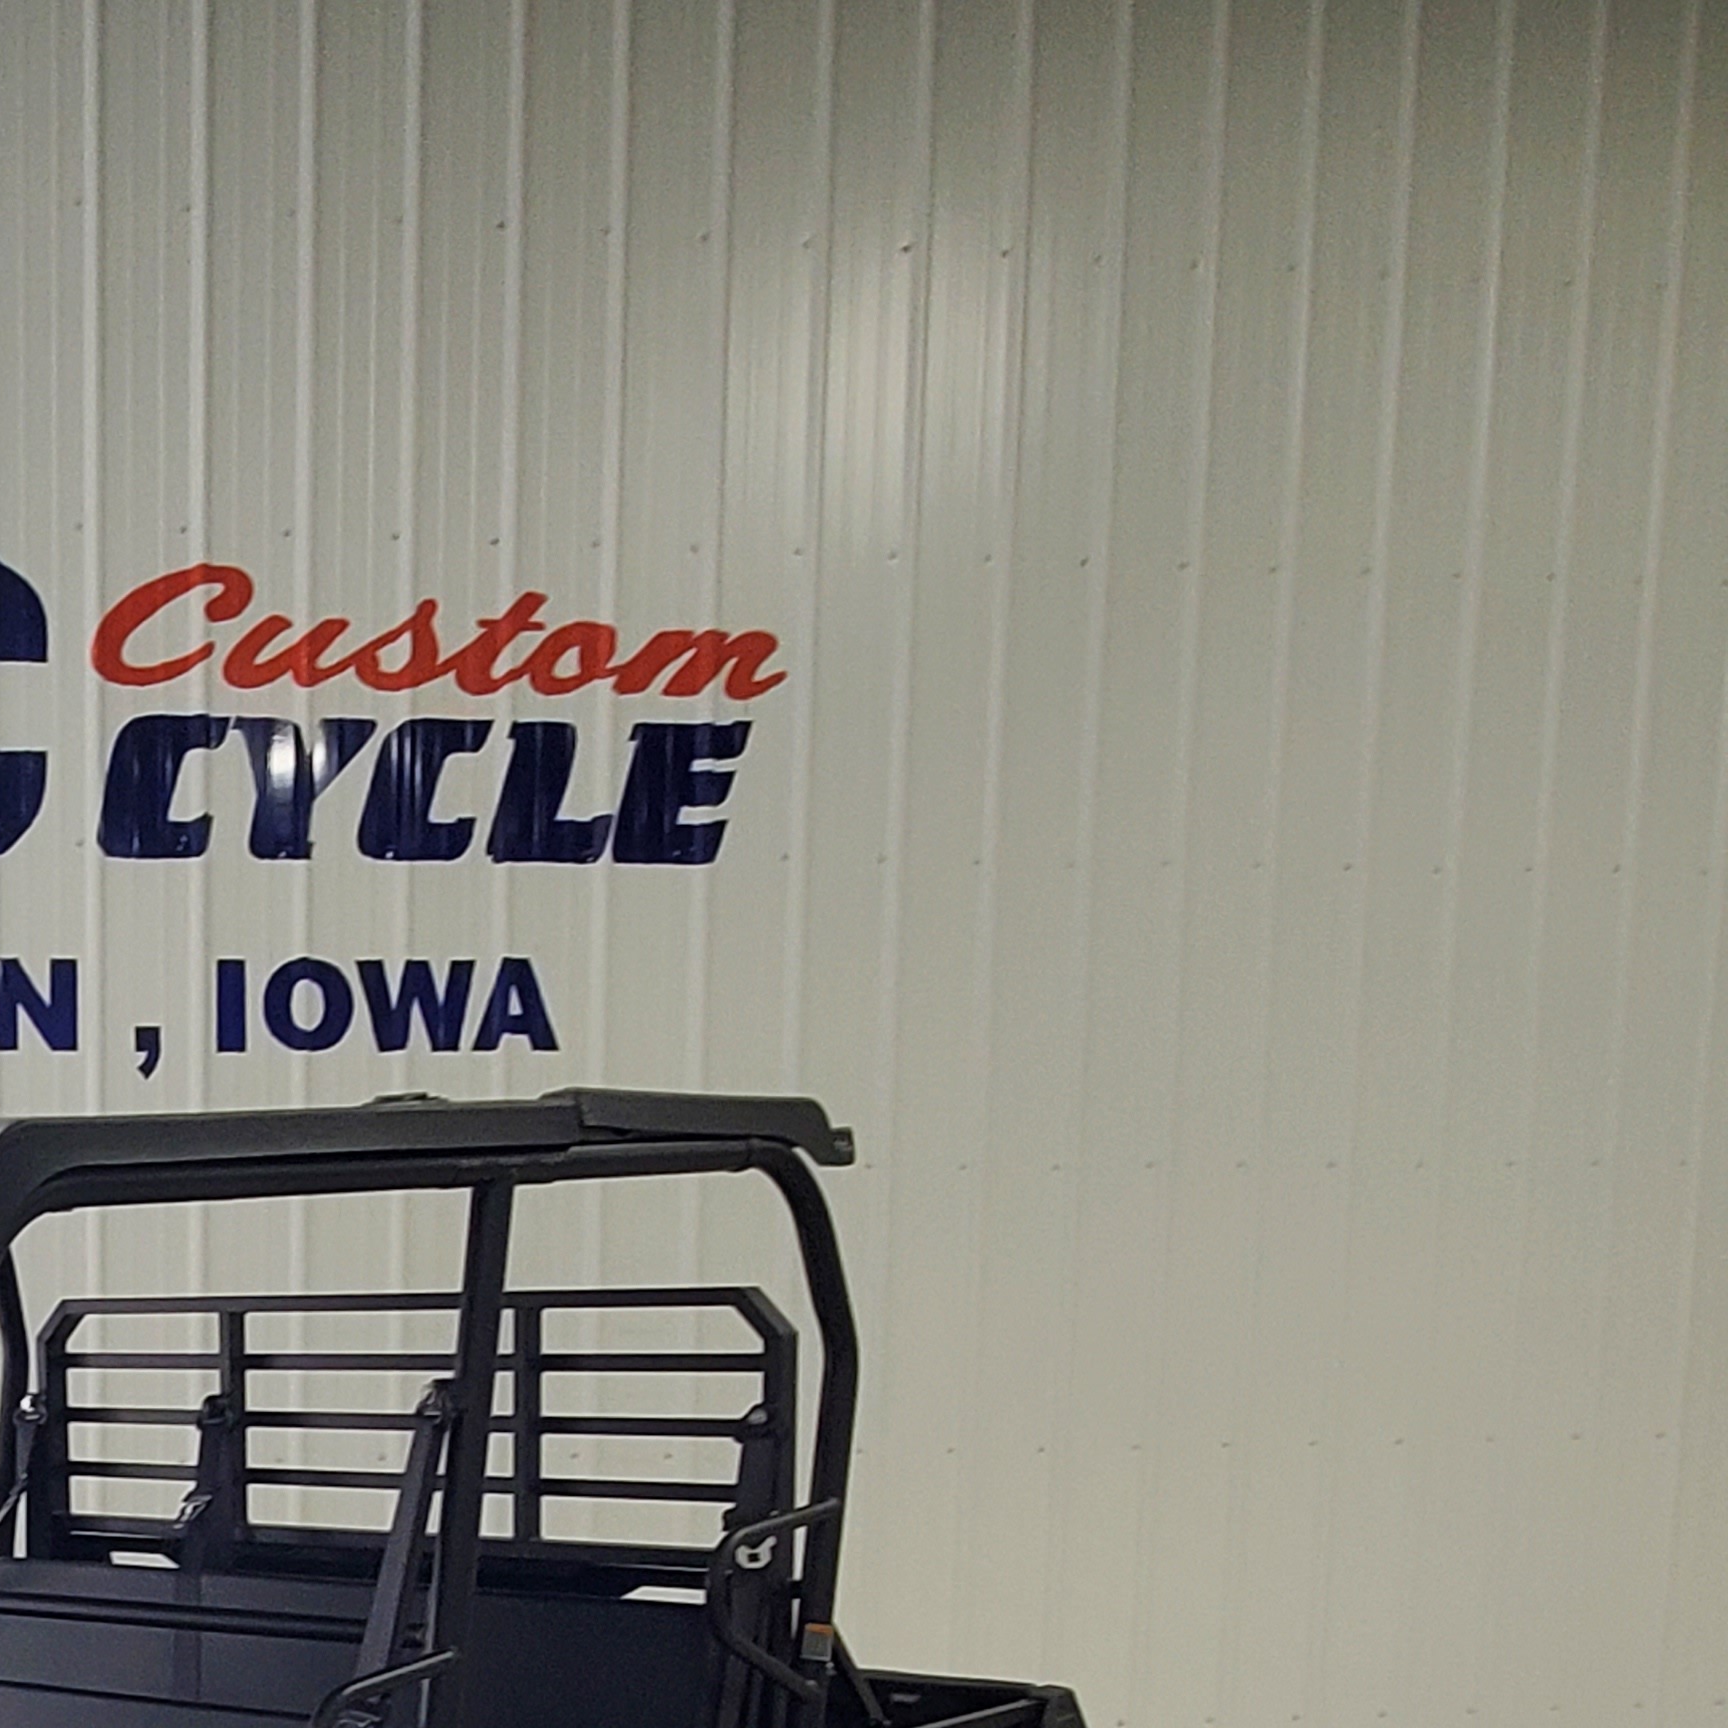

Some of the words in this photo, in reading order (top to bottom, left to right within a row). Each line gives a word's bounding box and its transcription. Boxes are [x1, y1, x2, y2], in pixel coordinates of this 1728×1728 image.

[92, 564, 787, 700] Custom
[97, 714, 753, 865] CYCLE
[217, 957, 559, 1052] IOWA
